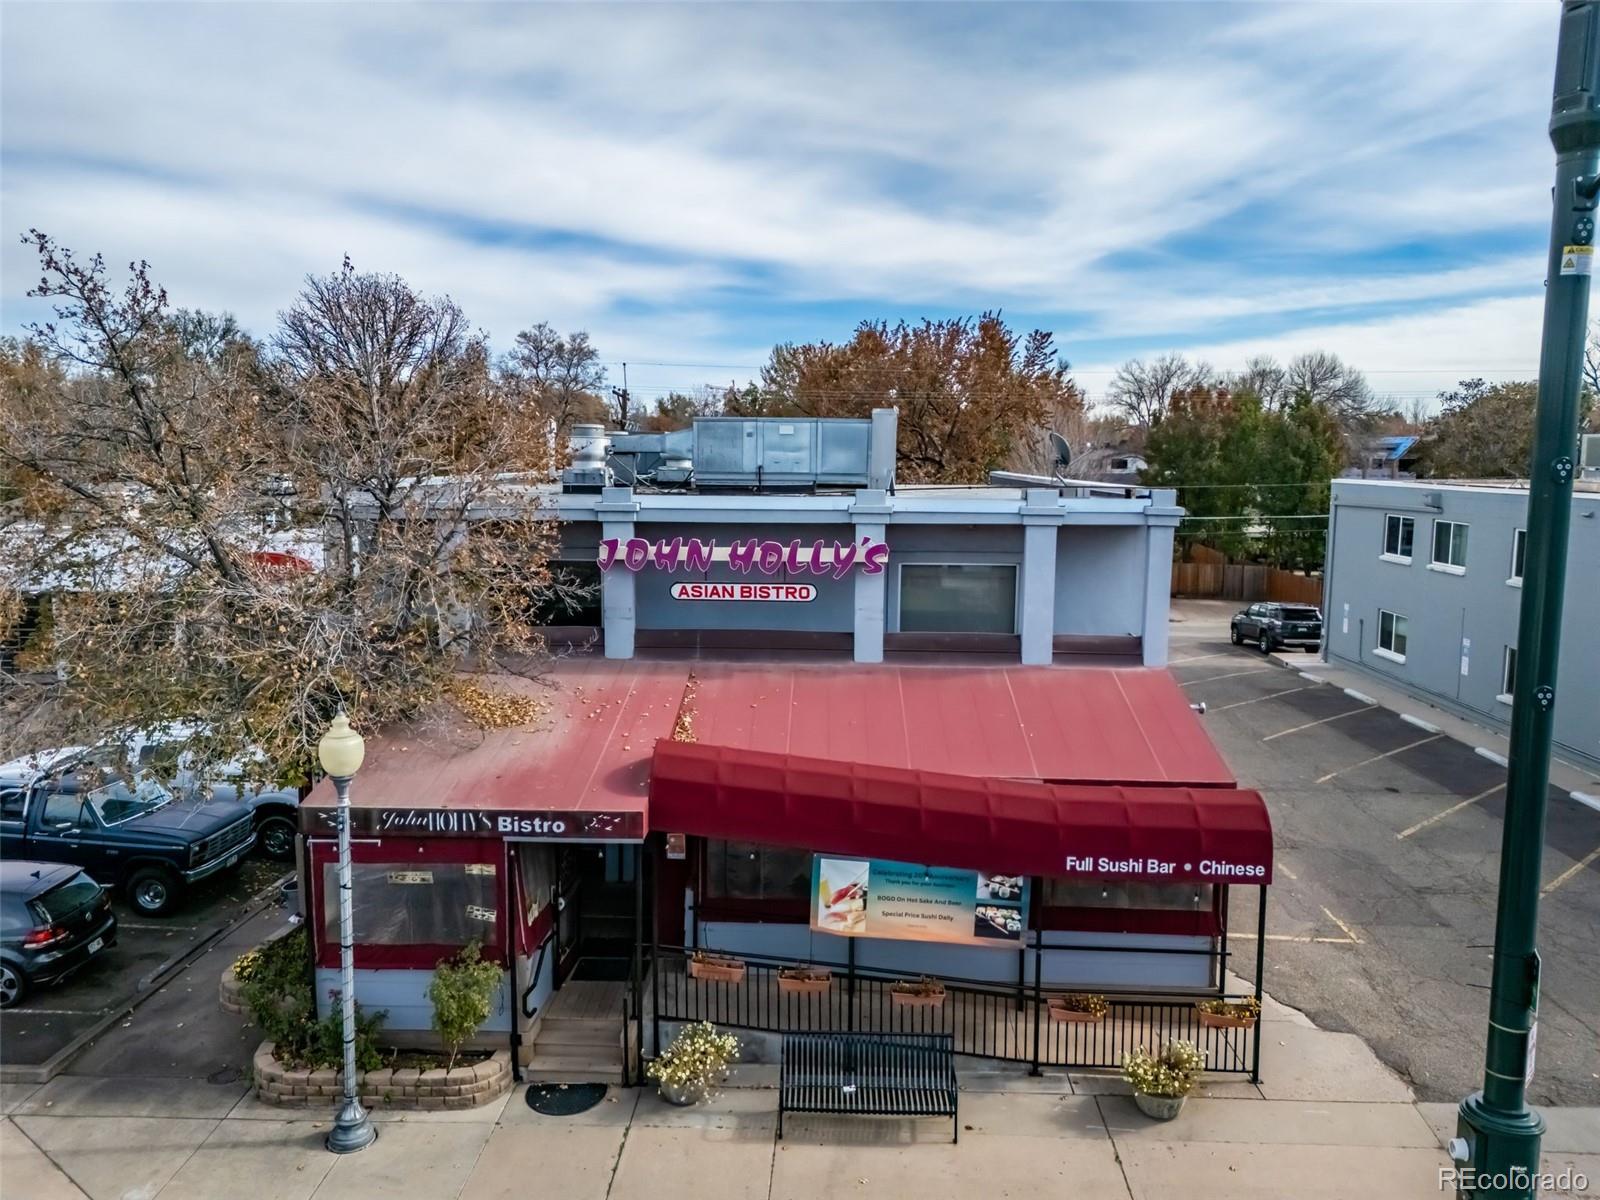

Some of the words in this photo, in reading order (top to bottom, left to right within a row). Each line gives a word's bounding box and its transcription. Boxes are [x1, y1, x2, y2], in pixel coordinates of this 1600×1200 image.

[596, 536, 716, 574] JOHN
[678, 585, 735, 599] ASIAN
[740, 585, 811, 600] BISTRO
[497, 816, 566, 833] Bistro
[1065, 856, 1094, 872] Full
[1097, 857, 1143, 873] Sushi
[1147, 859, 1176, 874] Bar
[1199, 860, 1265, 876] Chinese
[881, 910, 904, 918] Special
[920, 912, 938, 920] Sushi
